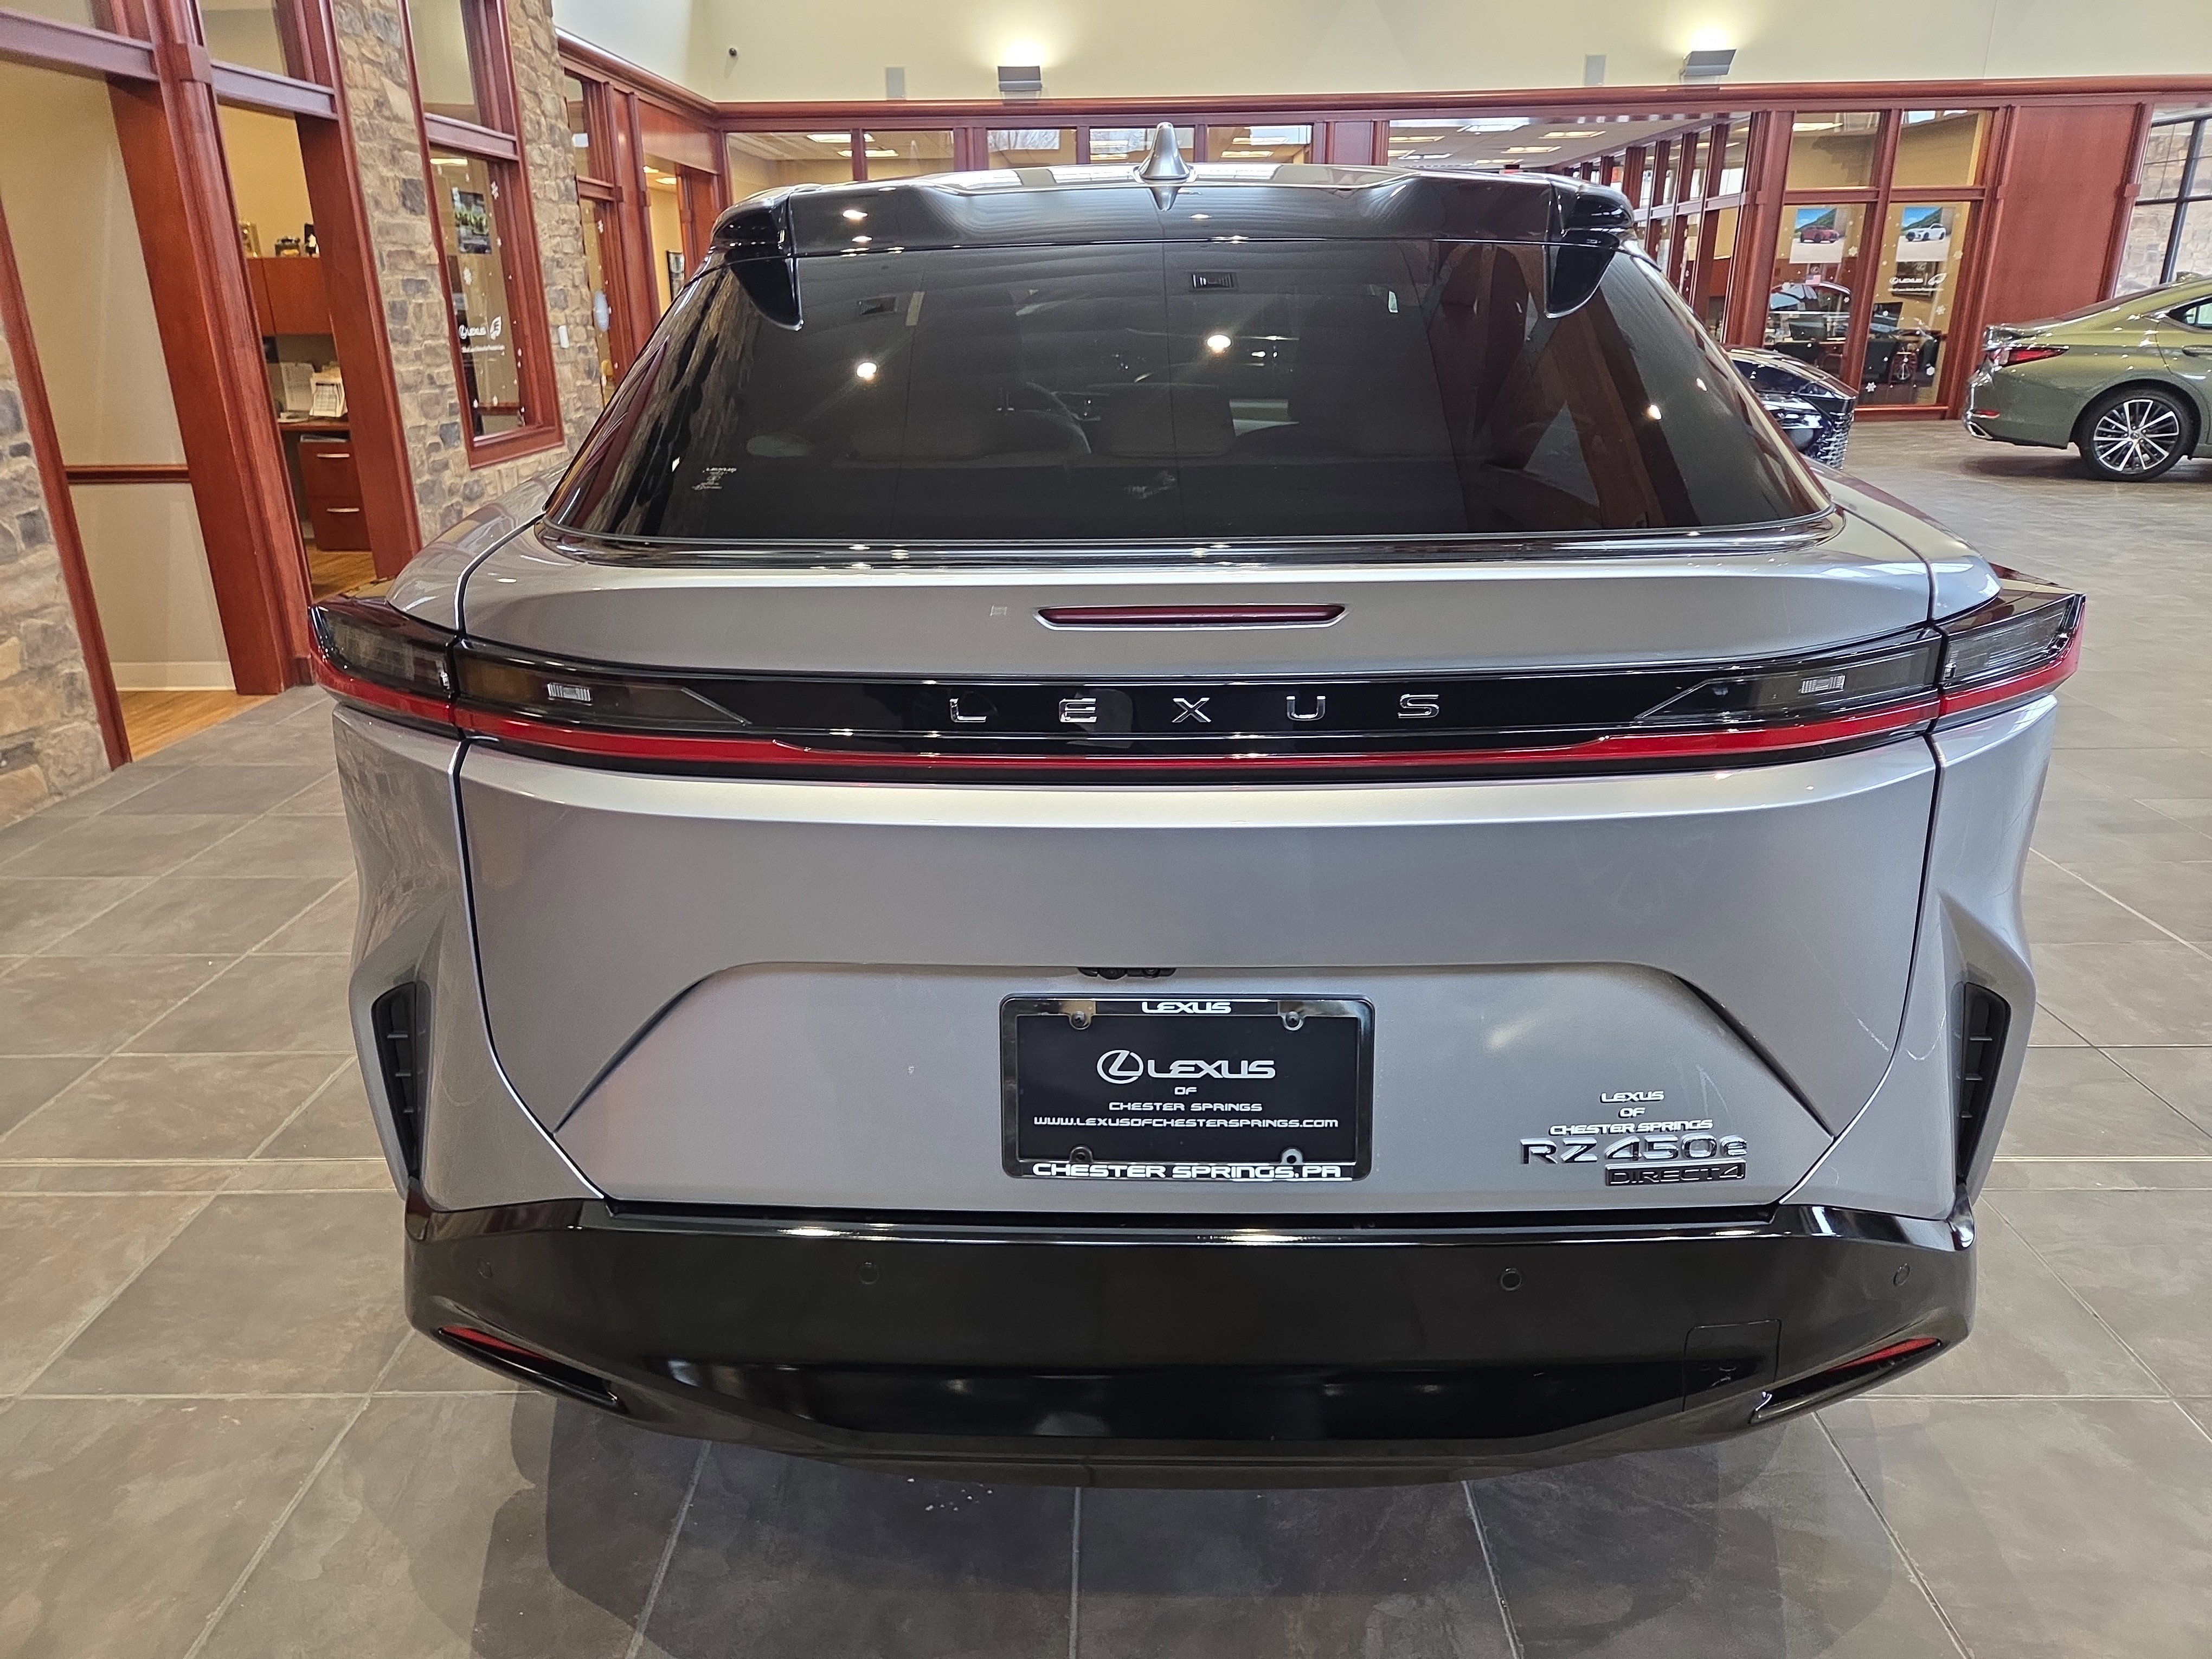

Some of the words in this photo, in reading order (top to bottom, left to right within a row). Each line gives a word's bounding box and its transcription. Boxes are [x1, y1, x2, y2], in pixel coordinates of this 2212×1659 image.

[949, 693, 1440, 724] LEXUS
[1141, 1001, 1232, 1014] LEXUS
[1147, 1059, 1276, 1079] LEXUS
[1174, 1086, 1197, 1095] OF
[1600, 1090, 1664, 1103] LEXUS
[1109, 1102, 1185, 1111] CHESTER
[1190, 1103, 1263, 1112] SPRINGS
[1618, 1107, 1646, 1118] OF
[1034, 1116, 1339, 1128] WWW.LEXUSOFCHESTERSPRINGS.COM
[1548, 1123, 1635, 1136] CHESTER
[1636, 1119, 1713, 1133] SPRINGS
[1032, 1163, 1166, 1178] CHESTER
[1610, 1165, 1745, 1185] DIRECT4
